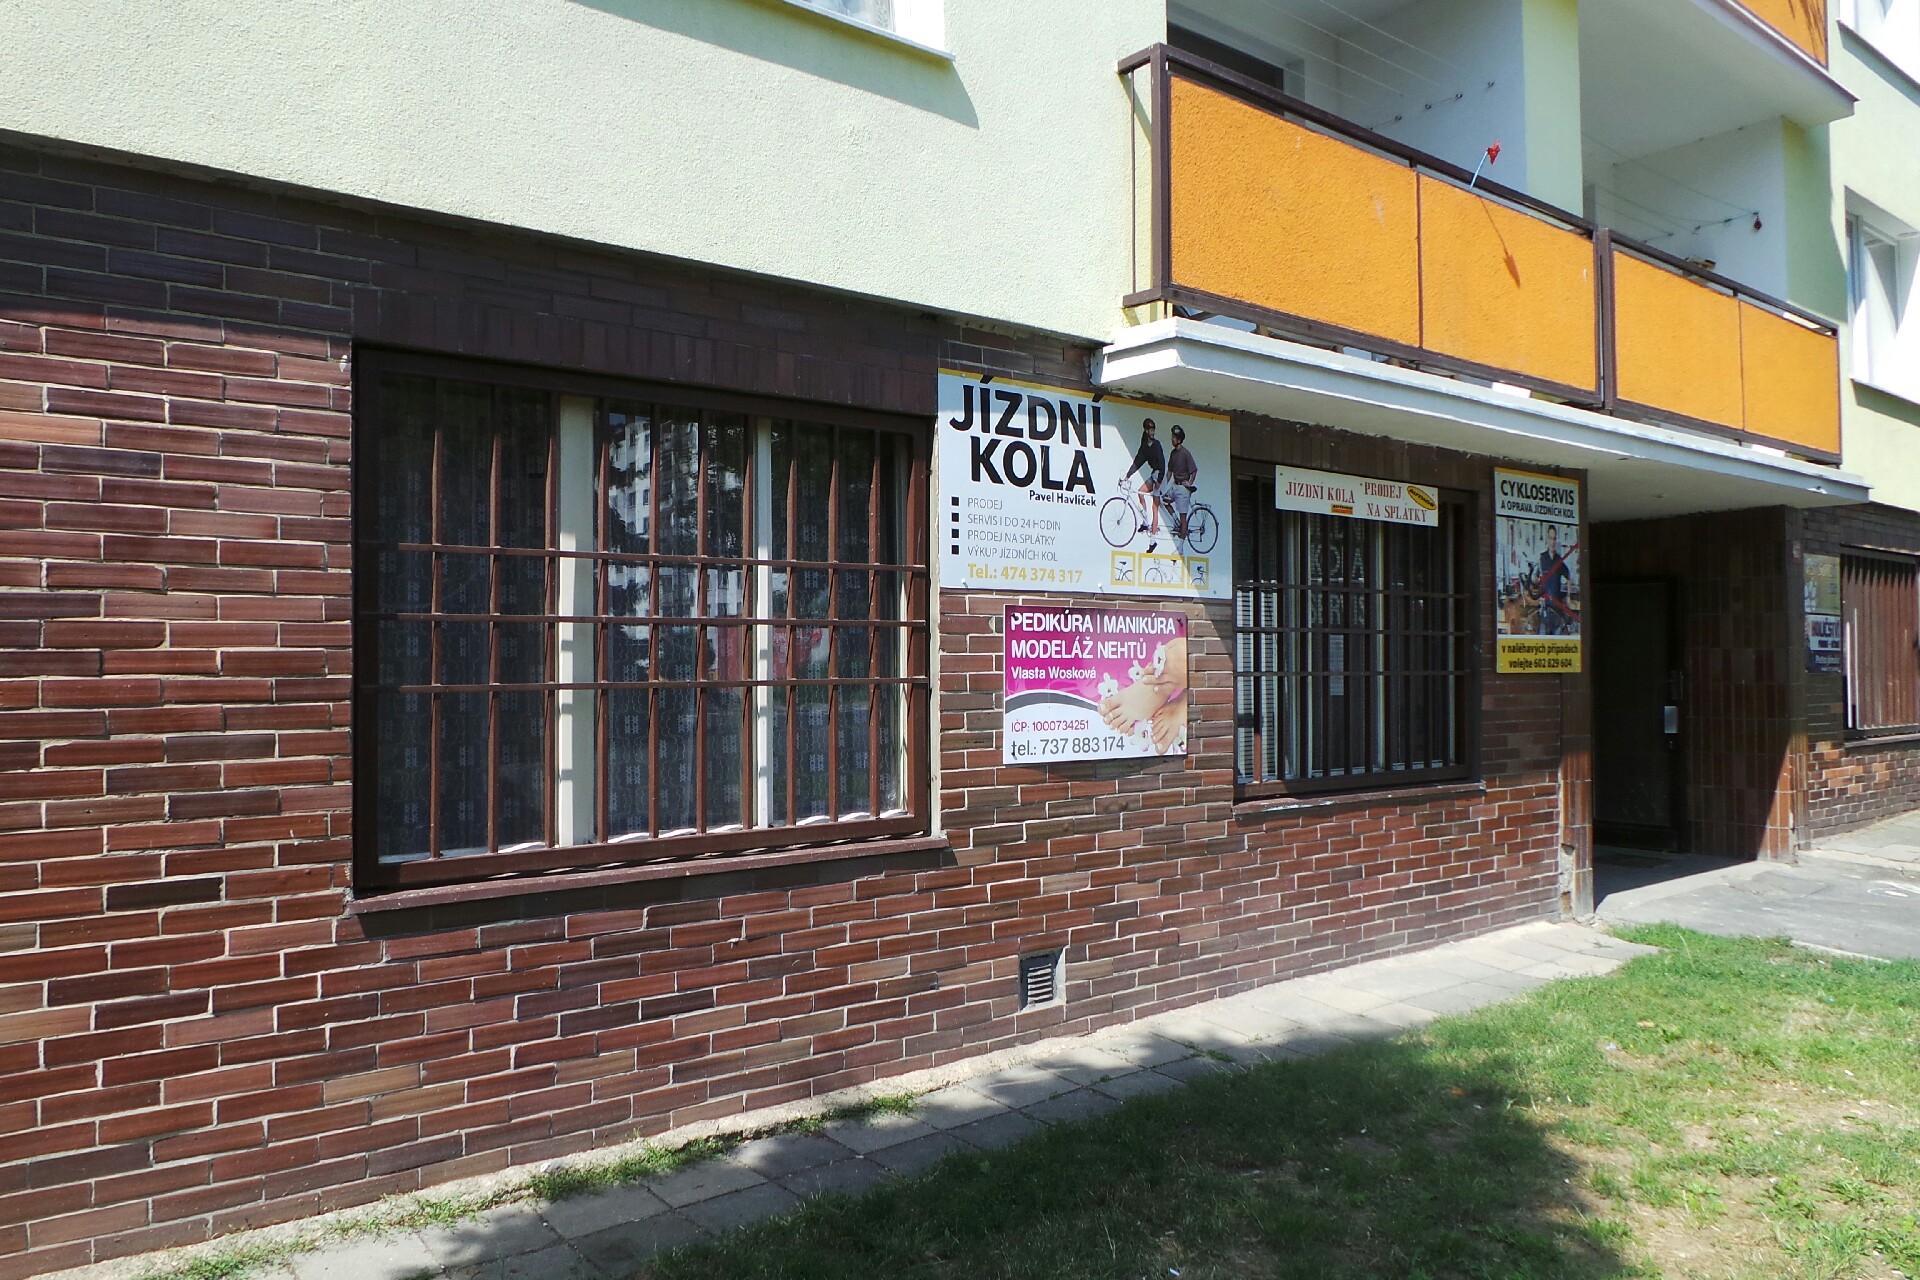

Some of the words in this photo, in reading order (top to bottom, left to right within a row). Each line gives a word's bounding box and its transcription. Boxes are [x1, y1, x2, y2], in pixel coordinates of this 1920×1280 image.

[949, 375, 1104, 449] JÍZDNÍ
[970, 435, 1096, 494] KOLA
[1029, 490, 1054, 503] Pavel
[1056, 493, 1097, 507] Havlíček
[1327, 487, 1355, 503] KOLA
[1364, 481, 1402, 499] PRODEJ
[1501, 480, 1575, 505] CYKLOSERVIS
[967, 497, 1003, 510] PRODEJ
[1367, 502, 1380, 517] NA
[1384, 503, 1427, 522] SPLÁTKY
[1501, 500, 1506, 509] A
[1506, 501, 1533, 513] OPRAVA
[1534, 503, 1562, 516] JÍZDNÍCH
[1563, 508, 1575, 518] KOL
[967, 513, 998, 526] SERVIS
[1004, 516, 1019, 528] DO
[1020, 518, 1031, 529] 24
[1032, 520, 1061, 531] HODIN
[967, 530, 1003, 542] PRODEJ
[1004, 532, 1018, 543] NA
[1019, 533, 1056, 546] SPLÁTKY
[967, 544, 998, 558] VÝKUP
[999, 546, 1040, 561] JÍZDNÍCH
[1041, 551, 1058, 562] KOL
[967, 563, 998, 579] Tel.:
[1000, 566, 1027, 580] 474
[1030, 568, 1056, 582] 374
[1058, 569, 1083, 583] 317
[1010, 609, 1093, 632] PEDIKÚRA
[1103, 613, 1176, 634] MANIKÚRA
[1011, 635, 1094, 659] MODELÁŽ
[1097, 637, 1147, 659] NEHTŮ
[1011, 666, 1046, 679] Vlasta
[1048, 666, 1097, 679] Wosková
[1509, 658, 1533, 670] volejte
[1534, 659, 1546, 668] 602
[1011, 719, 1030, 732] IČP:
[1032, 720, 1089, 732] 1000734251
[1011, 740, 1037, 756] tel.:
[1040, 738, 1069, 755] 737
[1072, 737, 1100, 754] 883
[1103, 736, 1125, 752] 174
